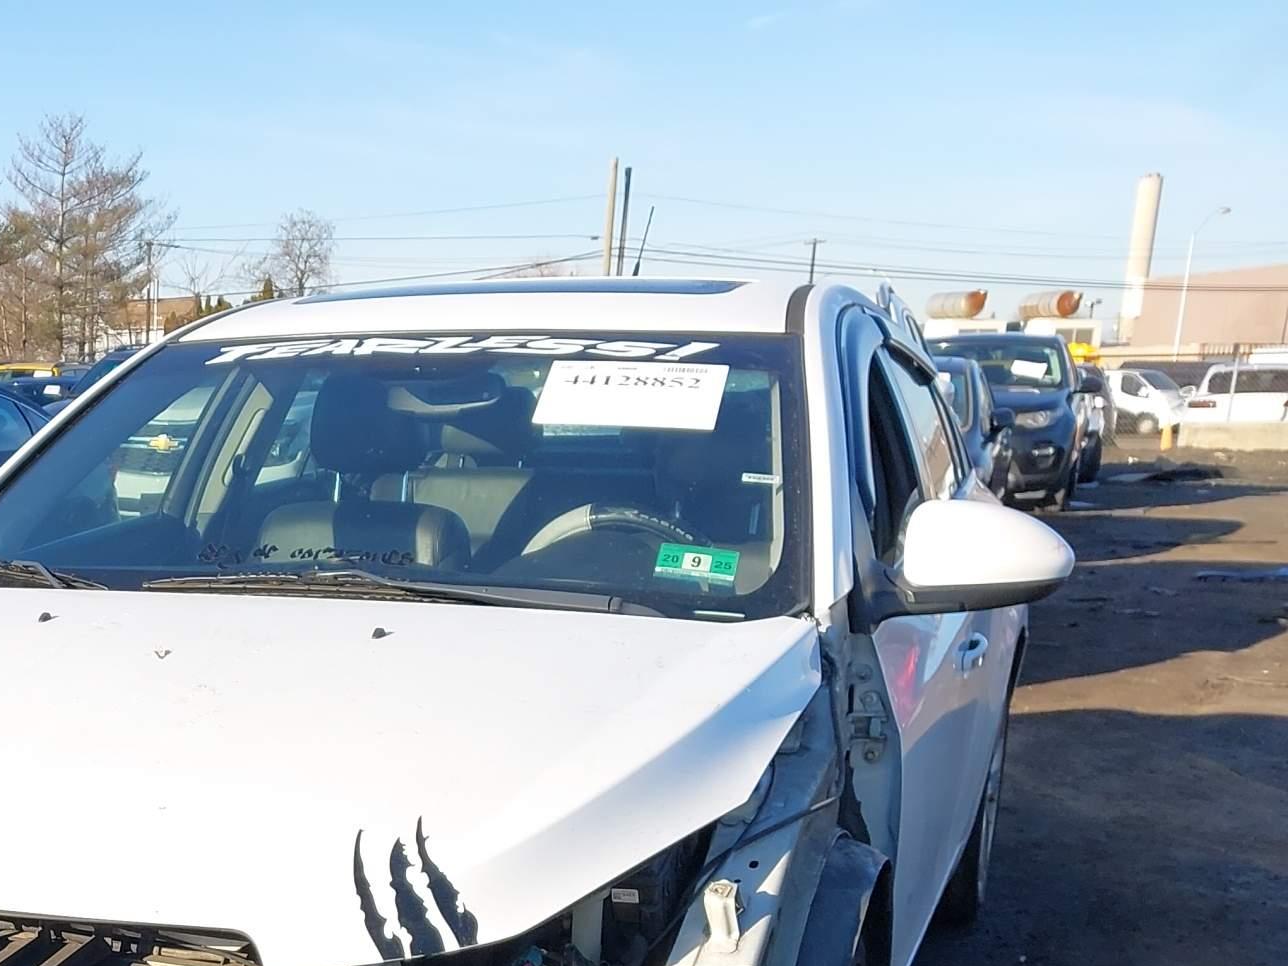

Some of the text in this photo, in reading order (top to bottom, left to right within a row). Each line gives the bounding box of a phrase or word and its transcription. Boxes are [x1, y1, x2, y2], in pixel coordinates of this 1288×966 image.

[205, 335, 720, 365] FEARLESS!
[564, 375, 701, 389] 44128852
[663, 554, 732, 570] 20 9 25
